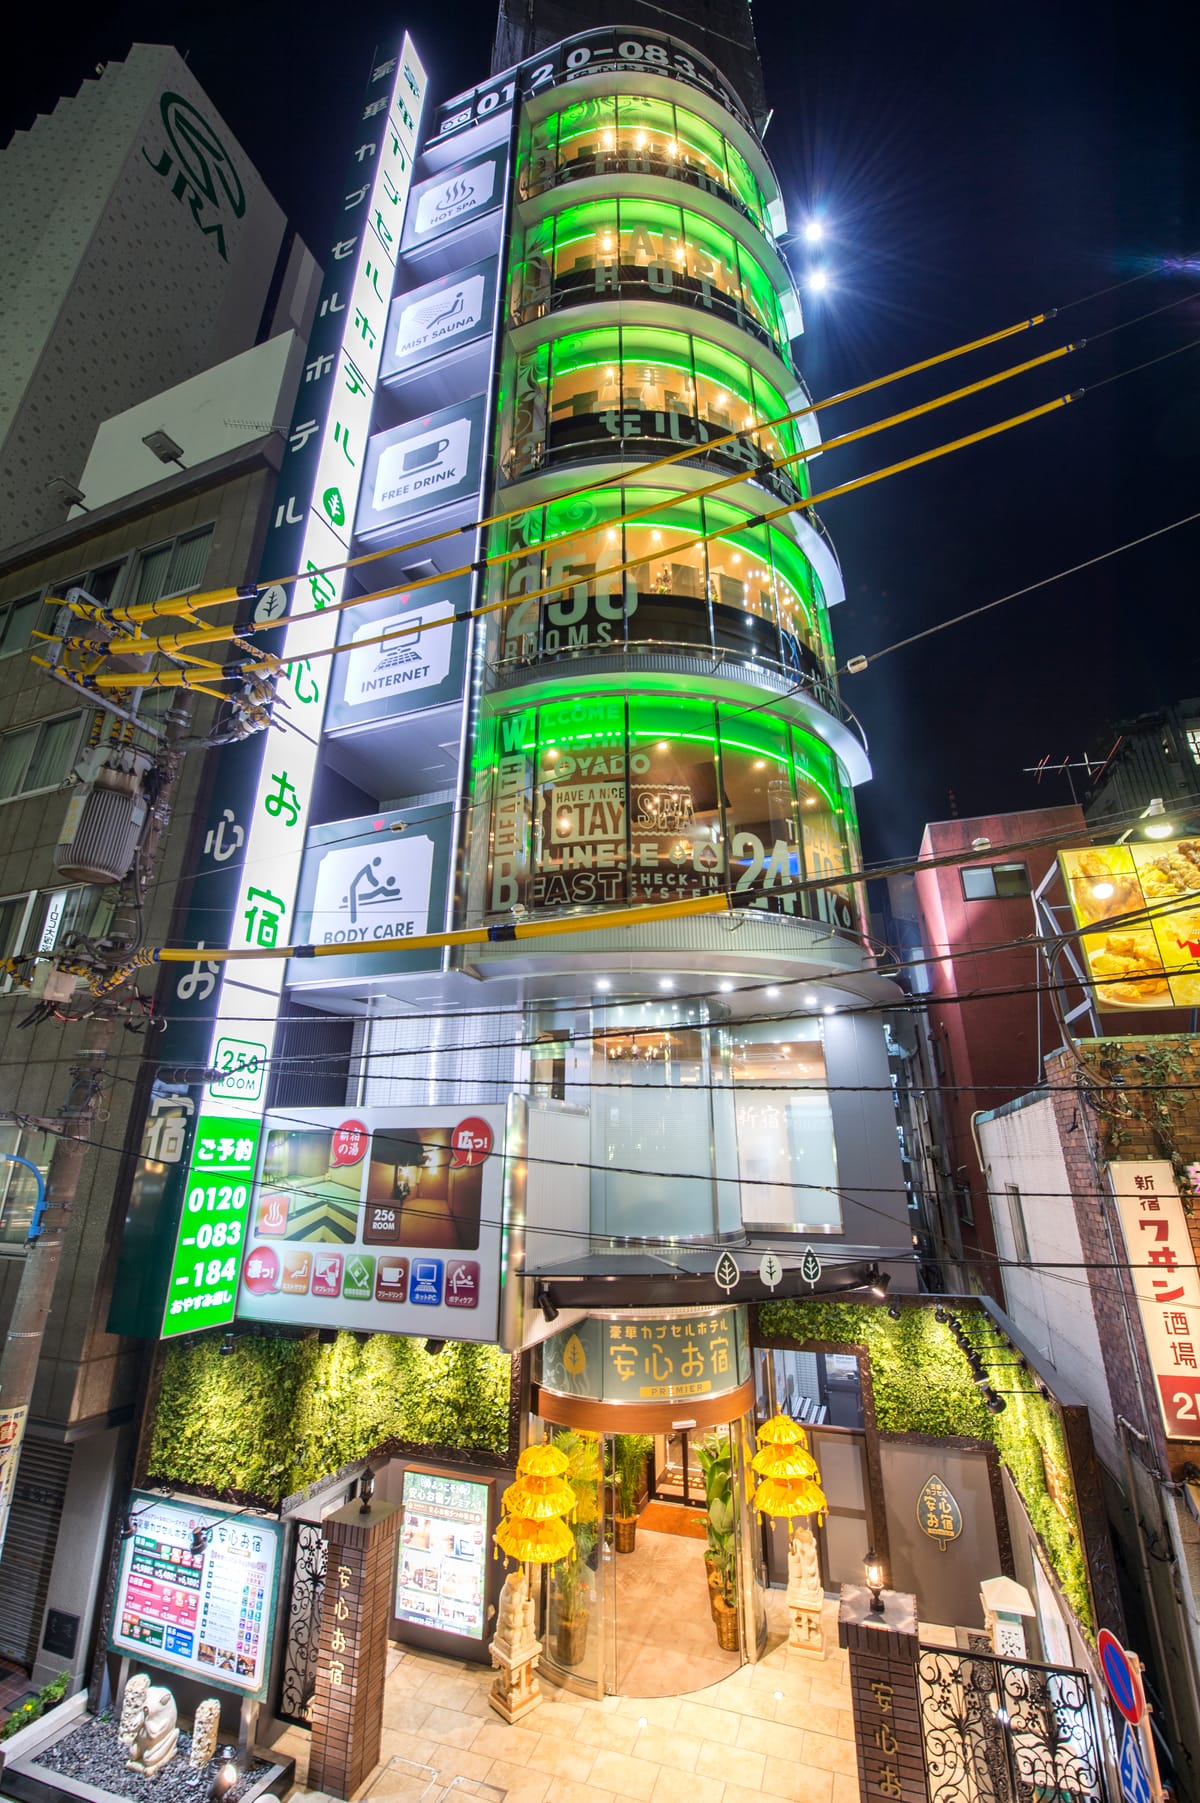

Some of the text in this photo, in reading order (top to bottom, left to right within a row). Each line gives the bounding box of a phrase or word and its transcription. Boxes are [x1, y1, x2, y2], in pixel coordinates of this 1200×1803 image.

[142, 146, 229, 264] JRA
[430, 199, 477, 224] HOT SPA
[401, 315, 475, 352] MIST SAUNA
[381, 468, 457, 502] FREE DRINK
[506, 545, 639, 640] 256
[361, 665, 431, 693] INTERNET
[244, 557, 336, 950] 安心お宿
[556, 790, 584, 803] HAVE
[600, 787, 625, 800] NICE
[555, 801, 625, 839] STAY
[629, 873, 719, 888] CHECK-IN
[324, 921, 414, 944] BODY CARE
[221, 1050, 258, 1074] 256
[198, 1138, 254, 1162] ご予約
[188, 1186, 247, 1213] 0120
[372, 1221, 396, 1231] ROOM
[374, 1208, 396, 1222] 256
[182, 1221, 241, 1249] -083
[175, 1257, 236, 1287] -184
[608, 1318, 729, 1340] 豪華カプセルホテル
[609, 1336, 729, 1382] 安心お宿
[923, 1495, 952, 1513] 安心
[927, 1512, 954, 1531] お宿
[218, 1526, 263, 1553] 安心お宿
[328, 1565, 353, 1686] 安心お宿
[871, 1682, 902, 1800] 安心お
